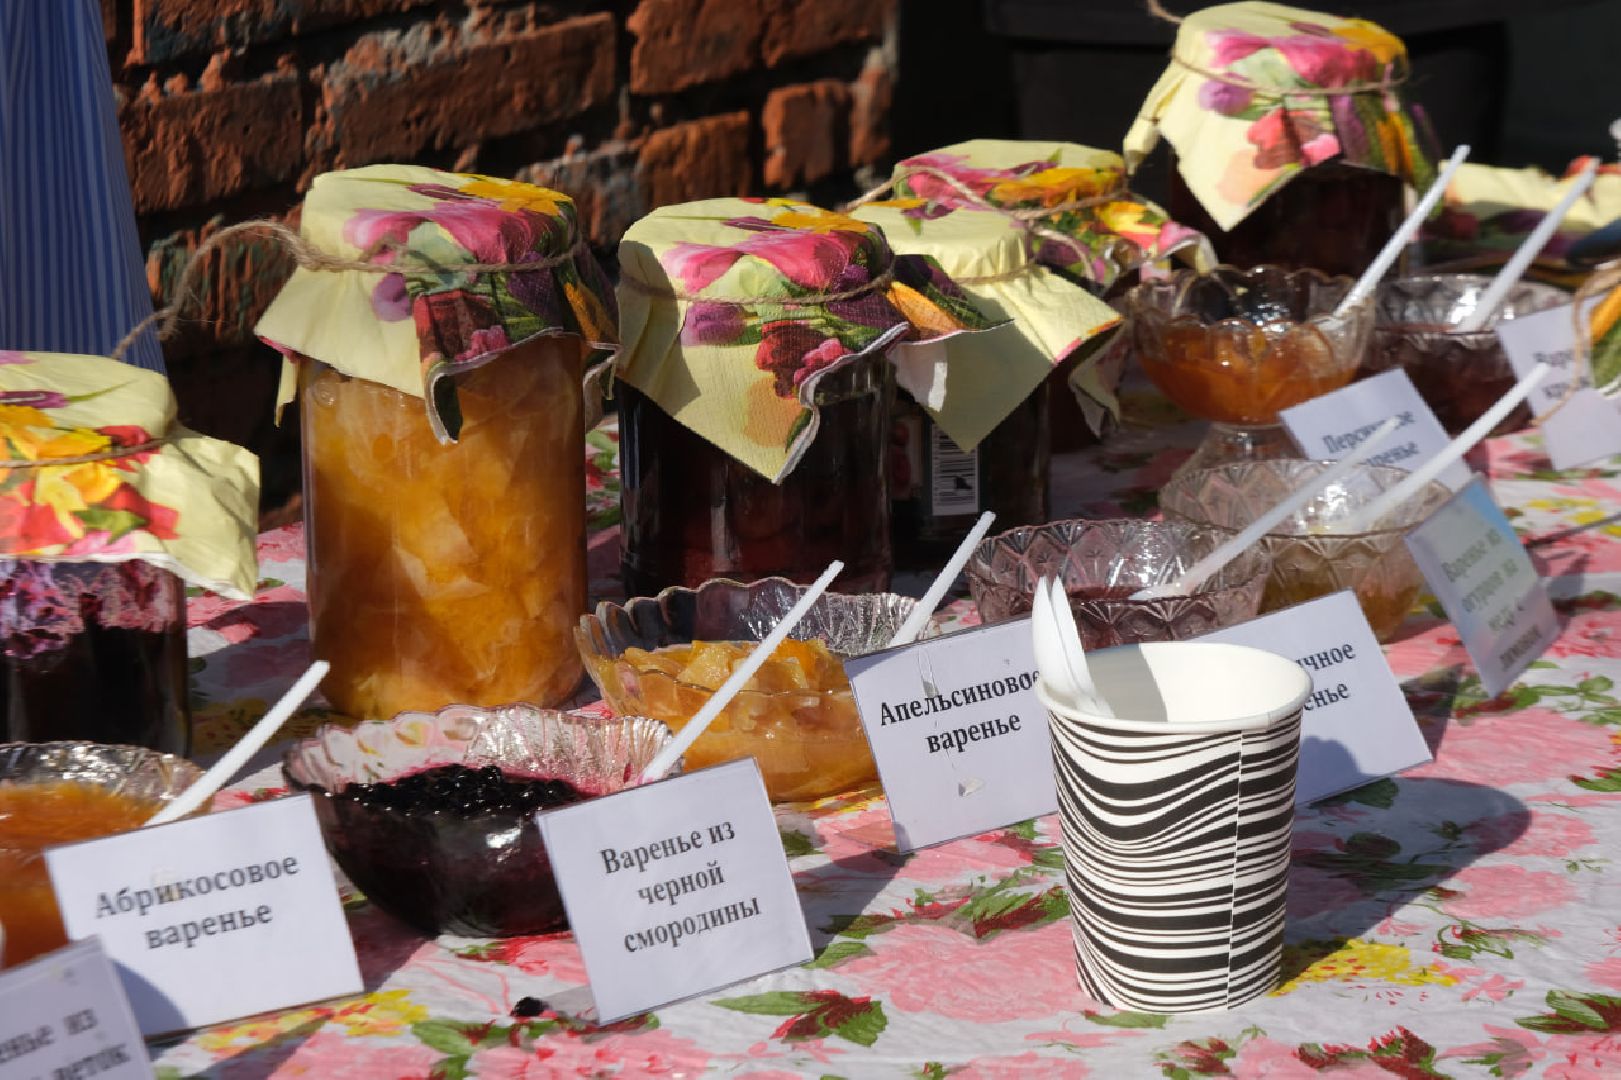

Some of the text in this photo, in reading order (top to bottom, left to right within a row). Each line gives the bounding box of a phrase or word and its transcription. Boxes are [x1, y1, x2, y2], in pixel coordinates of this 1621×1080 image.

[927, 714, 1022, 753] варенье
[600, 821, 736, 874] Варенье из
[96, 856, 300, 919] Абрикосовое
[638, 860, 726, 906] черной
[144, 904, 274, 950] варенье
[624, 897, 762, 953] смородины
